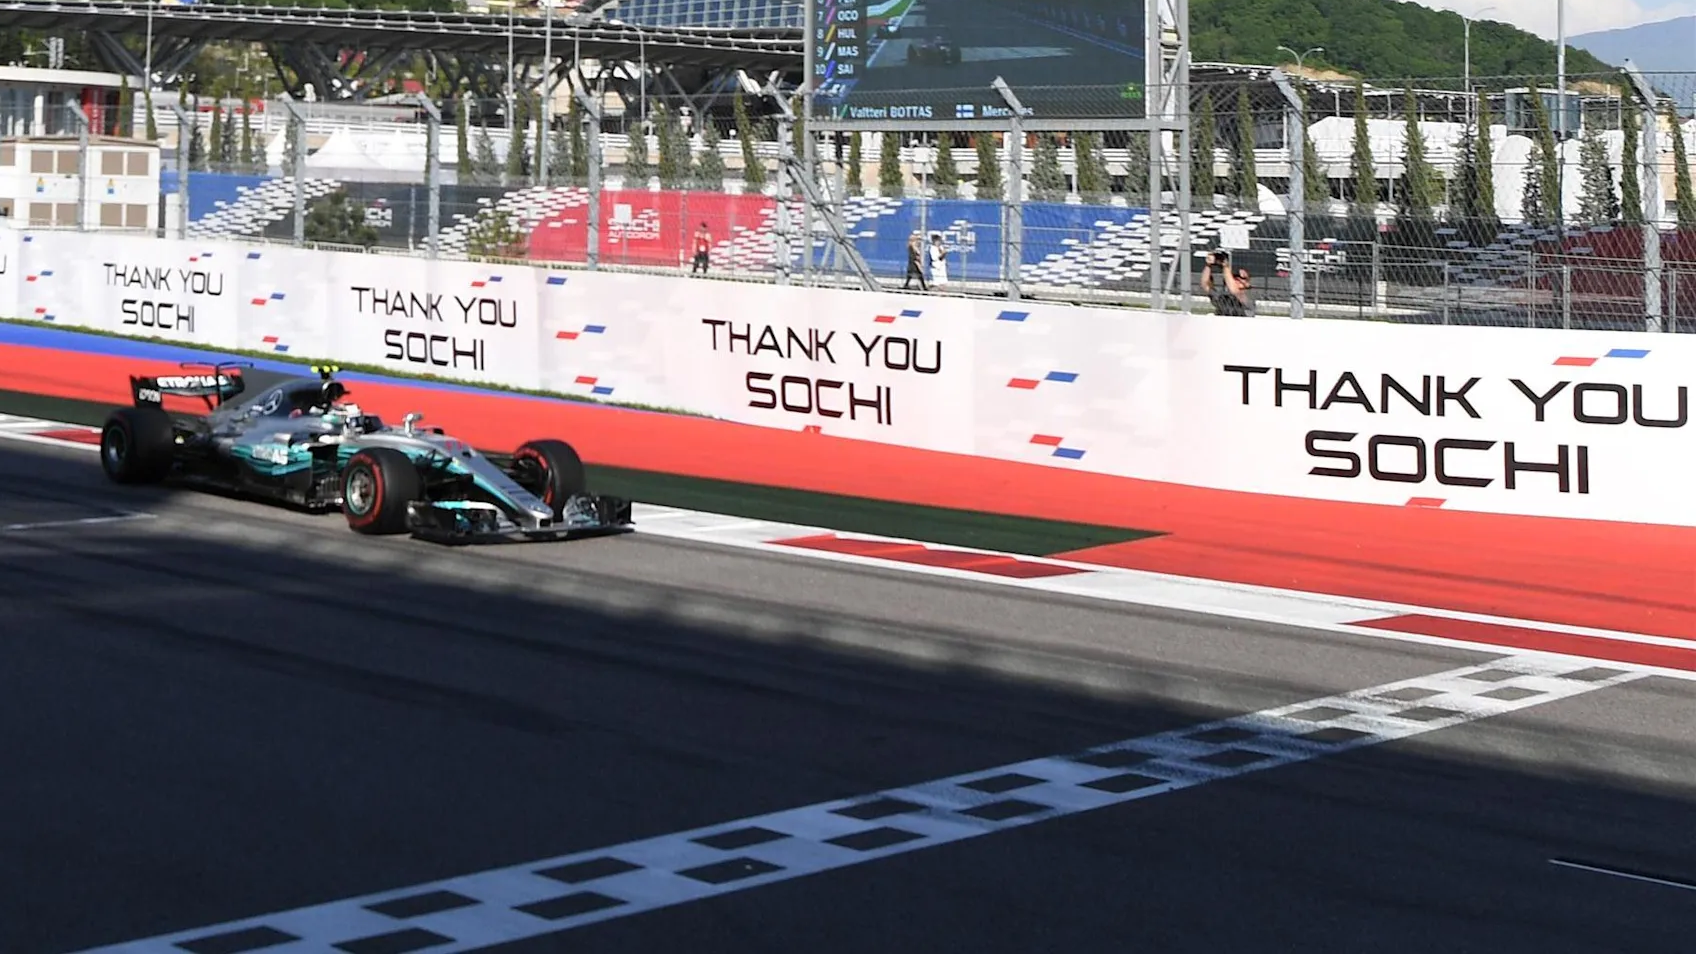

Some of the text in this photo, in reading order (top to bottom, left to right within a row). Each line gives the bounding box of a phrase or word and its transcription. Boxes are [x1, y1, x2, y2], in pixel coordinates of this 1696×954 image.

[817, 10, 858, 21] 7 OCO
[816, 28, 856, 39] 8 HUL
[815, 63, 854, 74] 10 SAI
[816, 46, 859, 57] 9 MAS
[850, 106, 887, 118] Valtteri
[890, 106, 933, 118] BOTTAS
[104, 263, 223, 297] THANK YOU
[121, 299, 195, 332] SOCHI
[351, 286, 517, 328] THANK YOU
[385, 329, 484, 371] SOCHI
[702, 318, 941, 374] THANK YOU
[746, 371, 892, 425] SOCHI
[1223, 364, 1688, 428] THANK YOU
[1304, 429, 1589, 494] SOCHI
